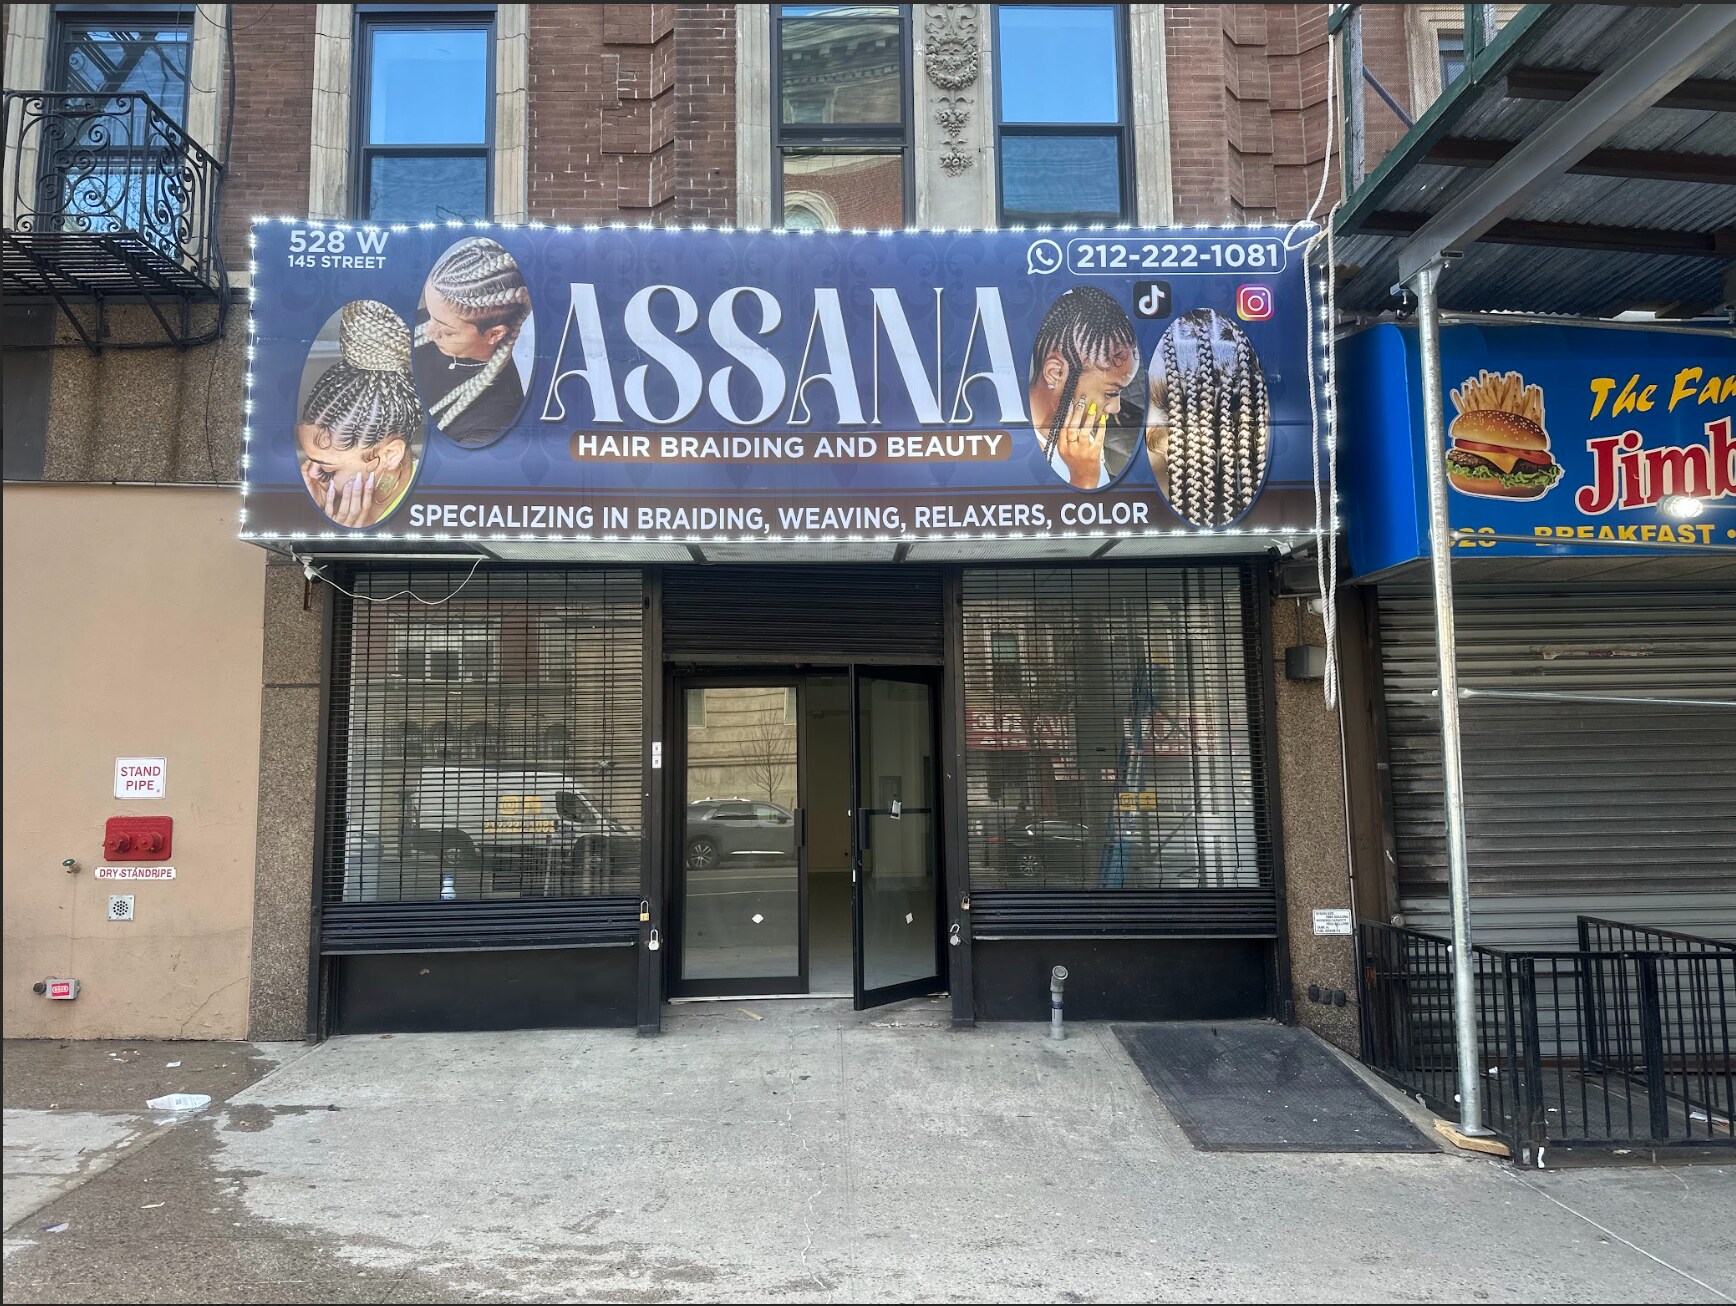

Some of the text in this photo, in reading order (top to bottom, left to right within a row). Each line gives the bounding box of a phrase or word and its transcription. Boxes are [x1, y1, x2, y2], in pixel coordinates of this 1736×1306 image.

[289, 230, 390, 254] 528 W
[288, 254, 387, 269] 145 STREET
[1076, 243, 1279, 269] 212-222-1081
[539, 282, 1032, 426] ASSANA
[1590, 373, 1658, 421] The
[577, 434, 1004, 460] HAIR BRAIDING AND BEAUTY
[408, 502, 1150, 535] SPECIALIZING IN BRAIDING, WEAVING, RELAXERS, COLOR
[120, 766, 161, 777] STAND
[126, 780, 155, 791] PIPE
[99, 868, 119, 878] DRY
